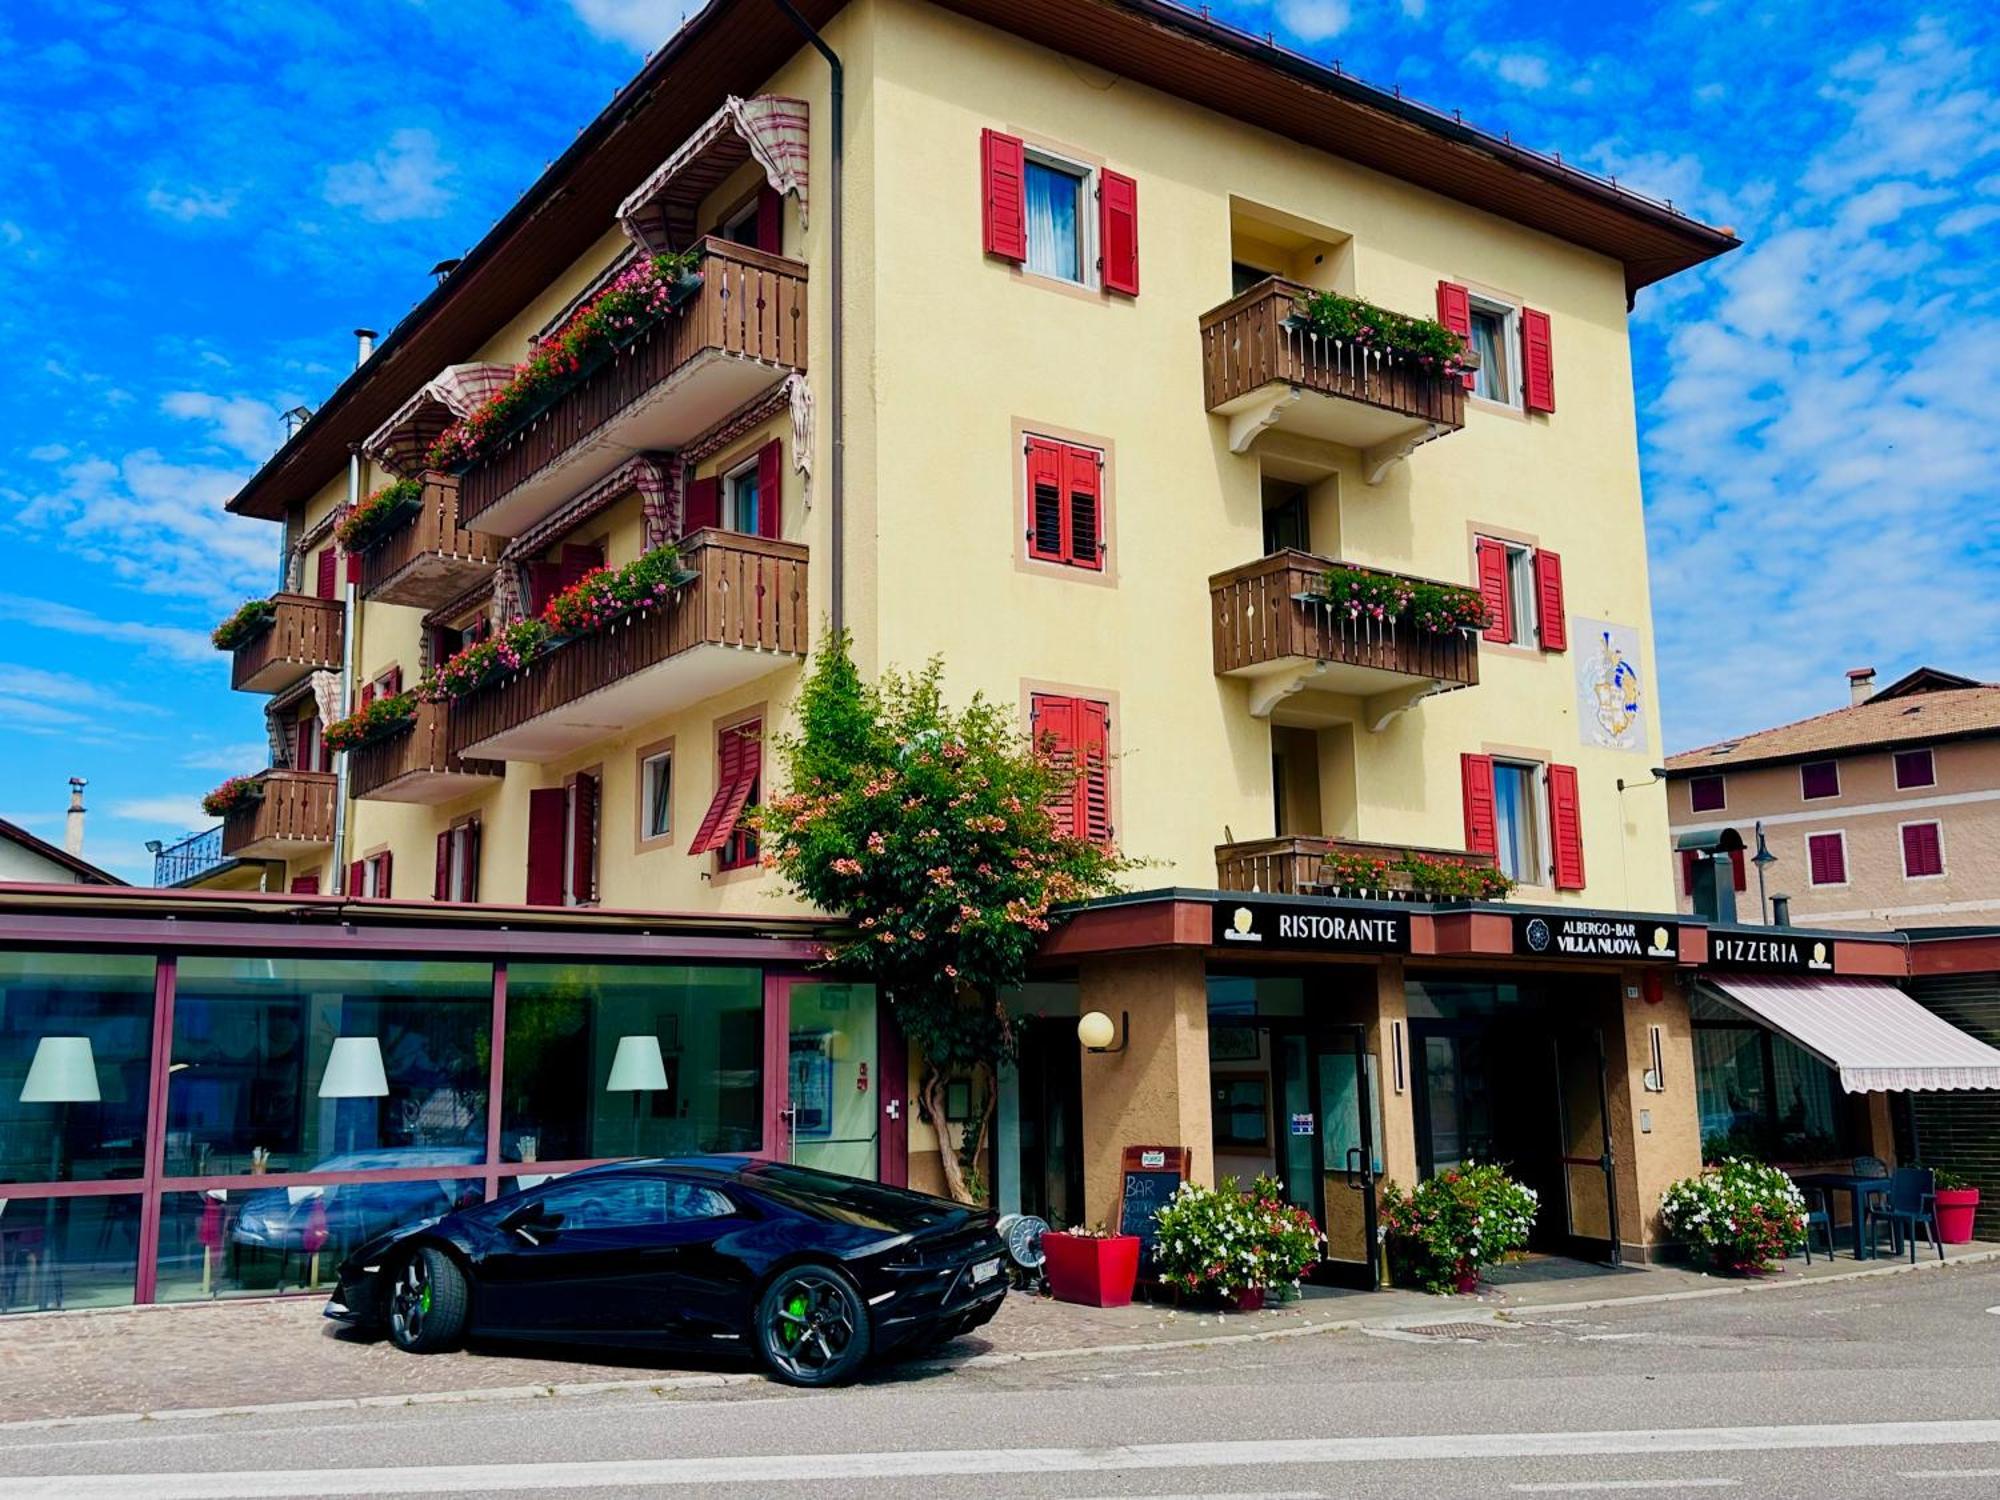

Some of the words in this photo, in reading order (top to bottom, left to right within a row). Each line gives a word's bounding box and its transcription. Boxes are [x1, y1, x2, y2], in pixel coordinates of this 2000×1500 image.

[1279, 914, 1398, 943] RISTORANTE
[1562, 920, 1636, 937] ALBERGO-BAR
[1556, 935, 1597, 953] VILLA
[1599, 937, 1642, 955] NUOVA
[1715, 939, 1799, 963] PIZZERIA
[1125, 1175, 1155, 1198] BAR
